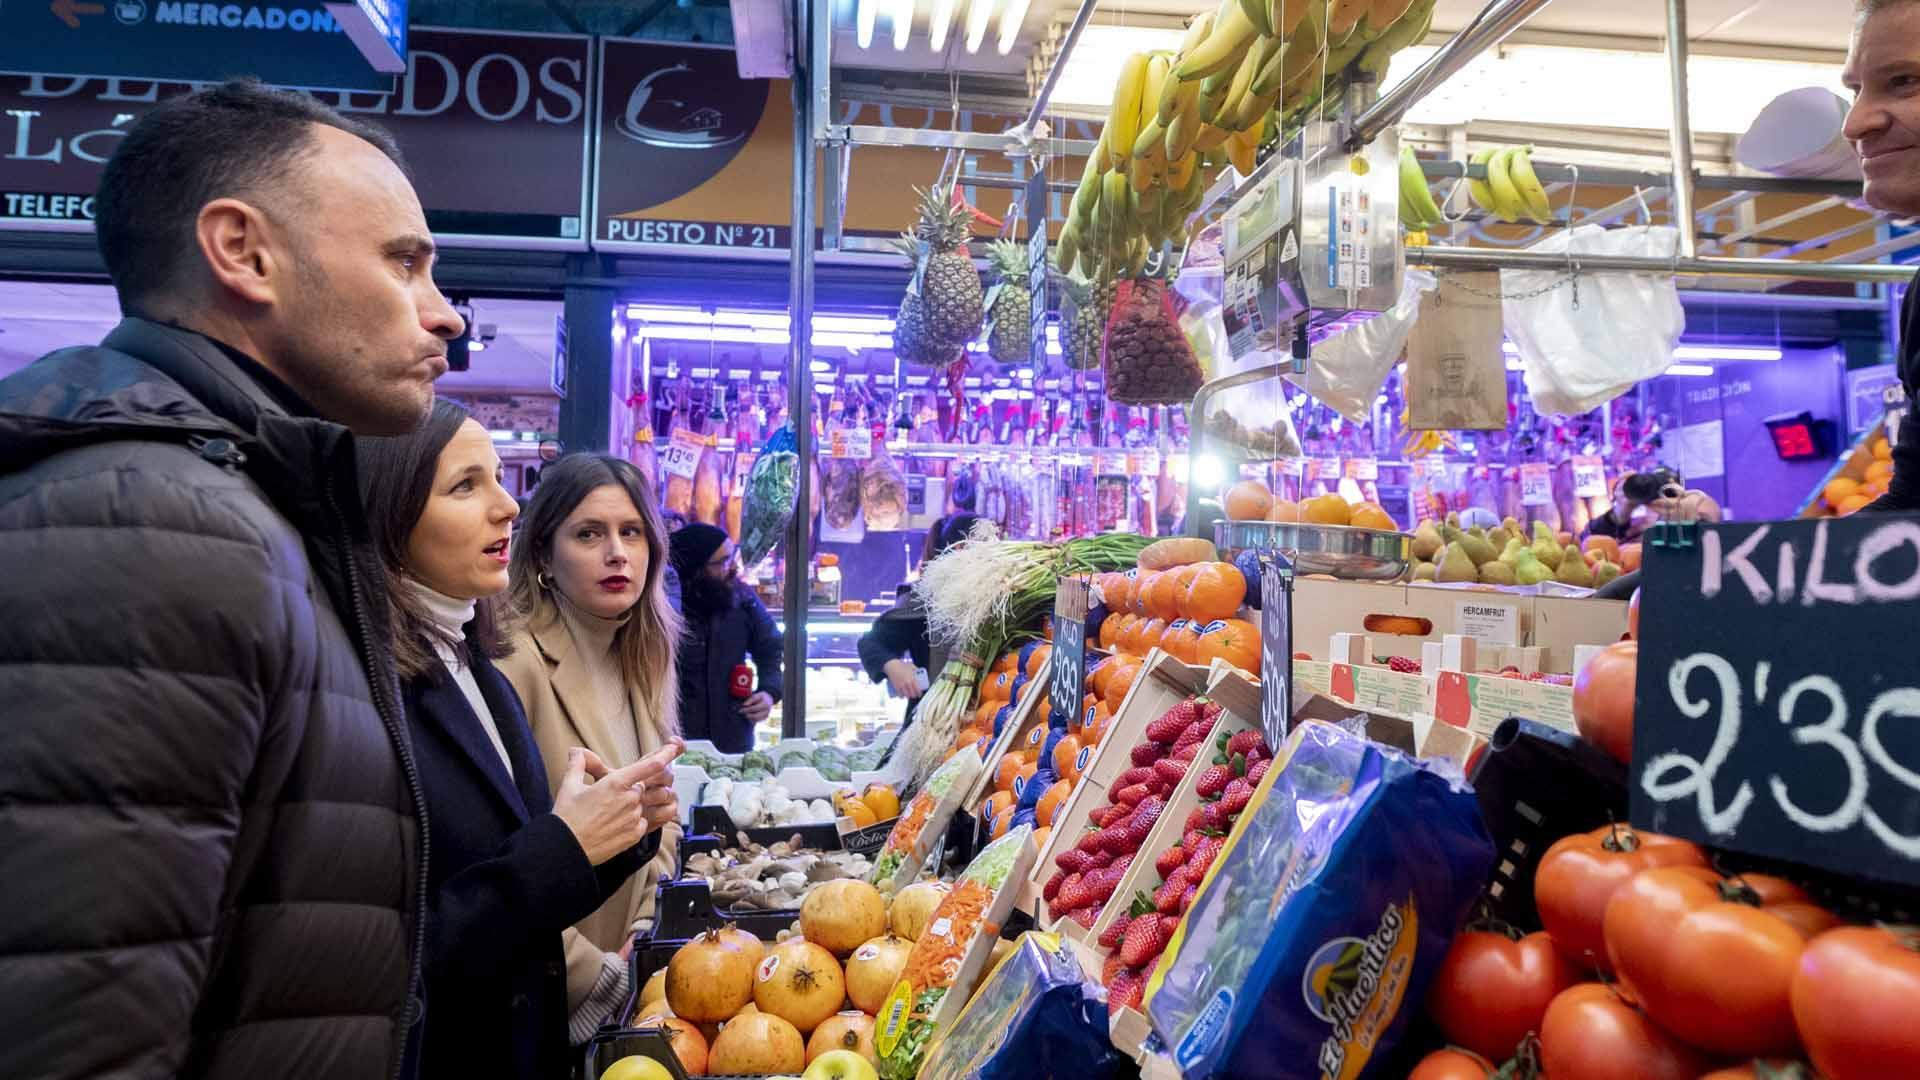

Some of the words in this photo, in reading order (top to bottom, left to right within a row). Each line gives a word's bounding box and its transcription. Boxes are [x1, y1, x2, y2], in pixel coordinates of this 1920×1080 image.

[155, 2, 344, 33] MERCADON
[607, 219, 705, 243] PUESTO
[715, 224, 744, 245] Nº
[751, 226, 776, 247] 21
[1701, 520, 1920, 603] KILO
[1463, 606, 1505, 617] HERCAMFRUT
[1330, 903, 1403, 1041] Huertico
